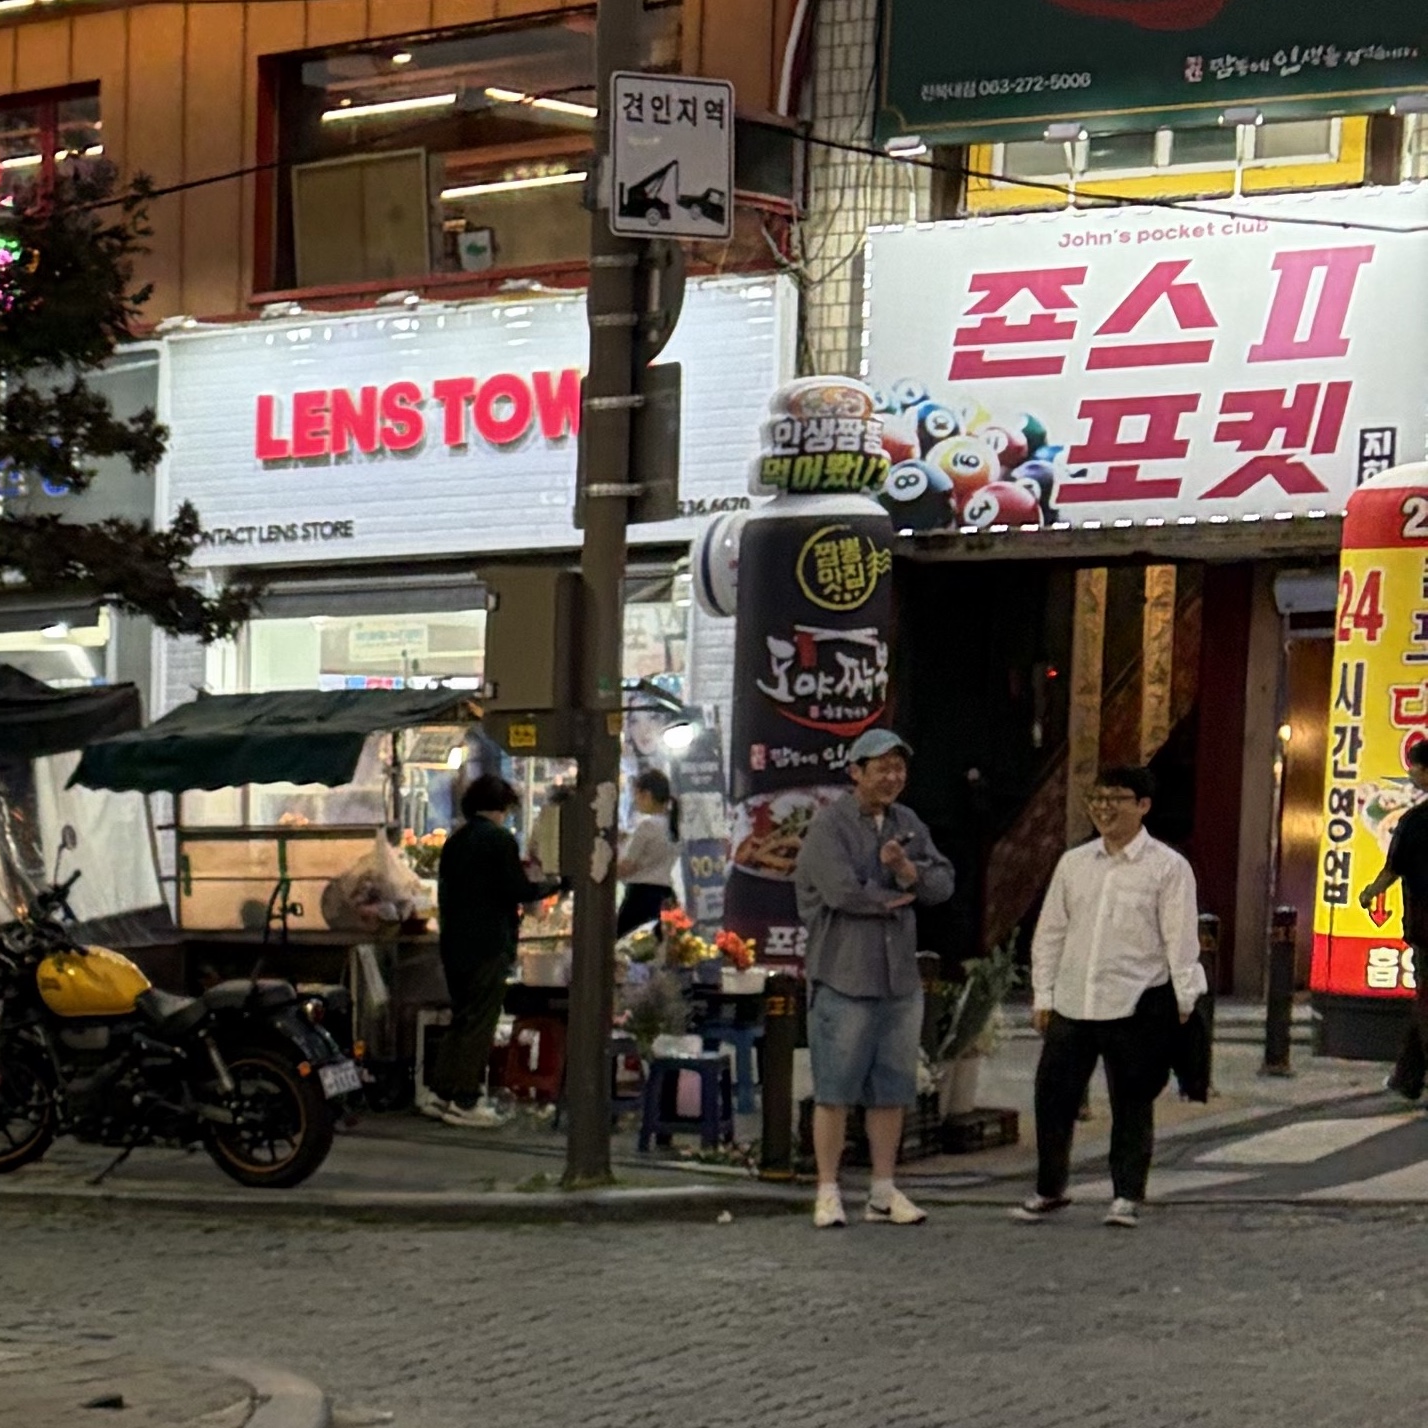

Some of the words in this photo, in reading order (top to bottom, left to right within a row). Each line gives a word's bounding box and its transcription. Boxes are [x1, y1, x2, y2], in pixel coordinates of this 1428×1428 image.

[622, 90, 725, 131] 견인지역
[1058, 228, 1132, 249] John's
[1136, 221, 1216, 245] pocket
[1221, 216, 1270, 238] club
[947, 259, 1221, 382] 존스
[254, 380, 424, 461] LENS
[431, 369, 580, 446] TOW
[1054, 380, 1355, 504] 포켓
[188, 525, 255, 548] ONTACT
[258, 522, 298, 544] LENS
[301, 519, 355, 542] STORE
[1337, 569, 1385, 642] 24
[1323, 661, 1363, 905] 시간영업
